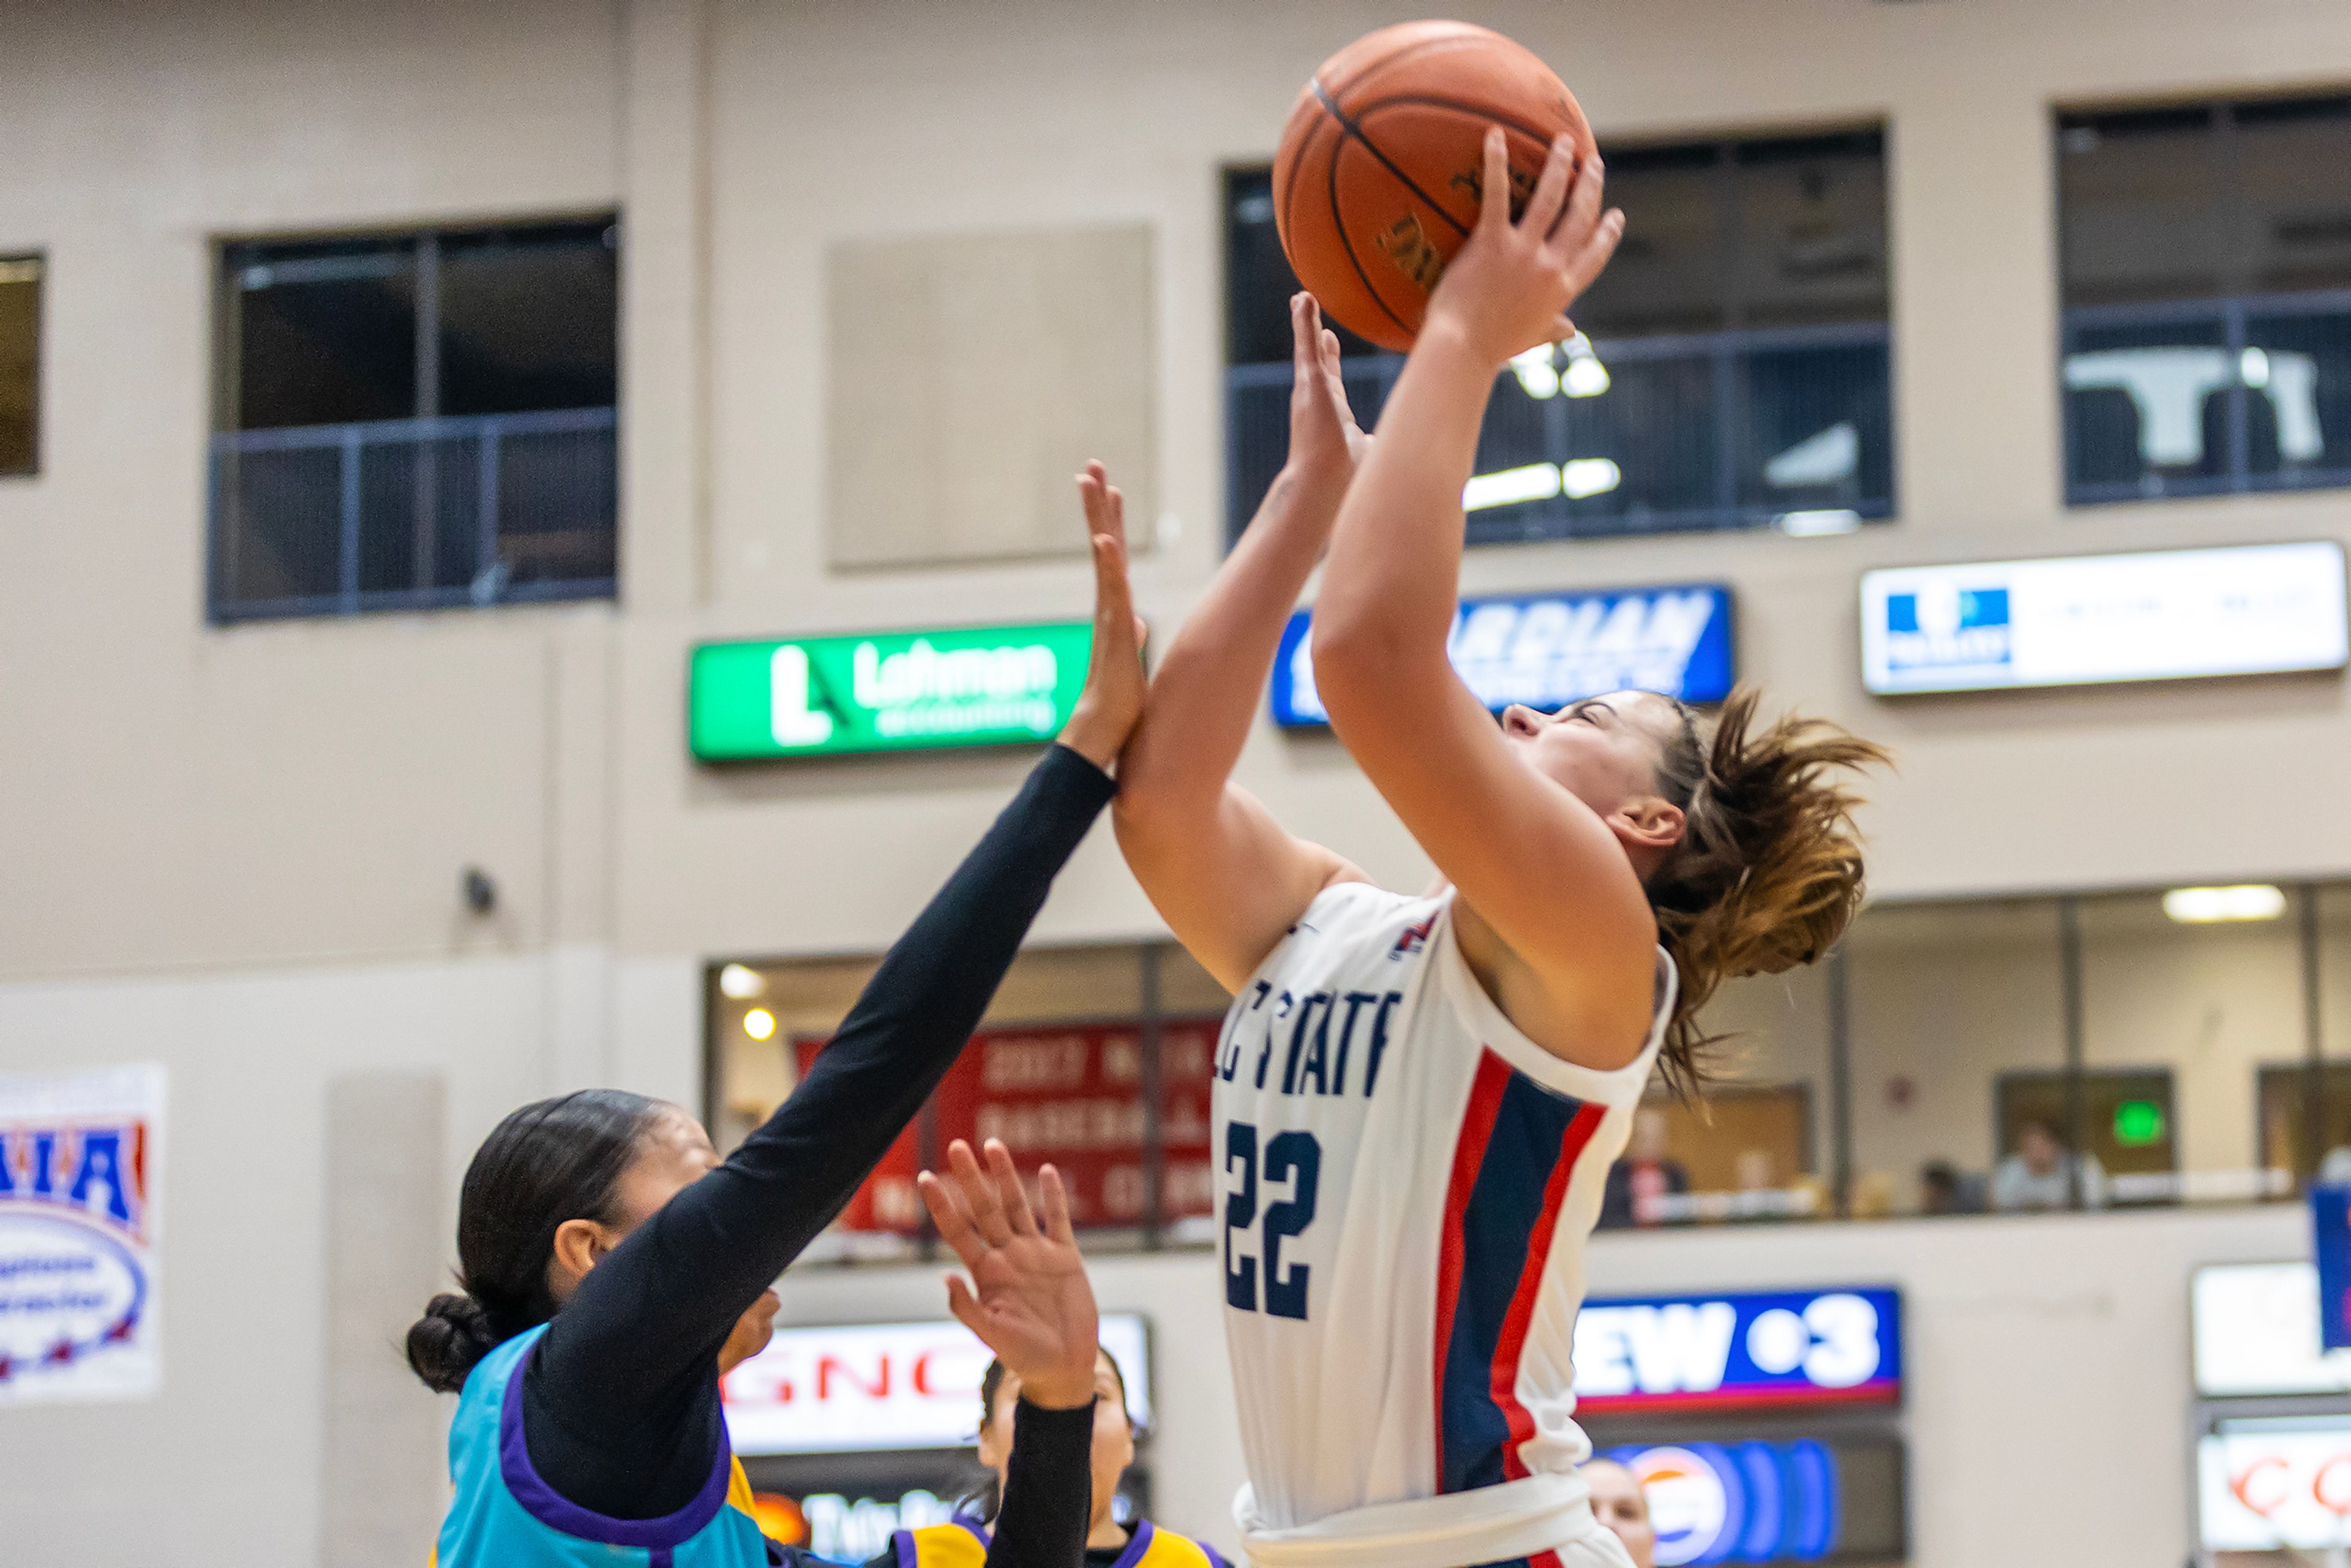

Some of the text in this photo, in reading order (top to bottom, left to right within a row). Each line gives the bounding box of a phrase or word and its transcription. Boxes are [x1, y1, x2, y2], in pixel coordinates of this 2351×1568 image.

[770, 644, 833, 746] L
[853, 638, 1058, 709] Lehman
[1226, 1120, 1322, 1321] 22
[1570, 1293, 1881, 1397] EW 3
